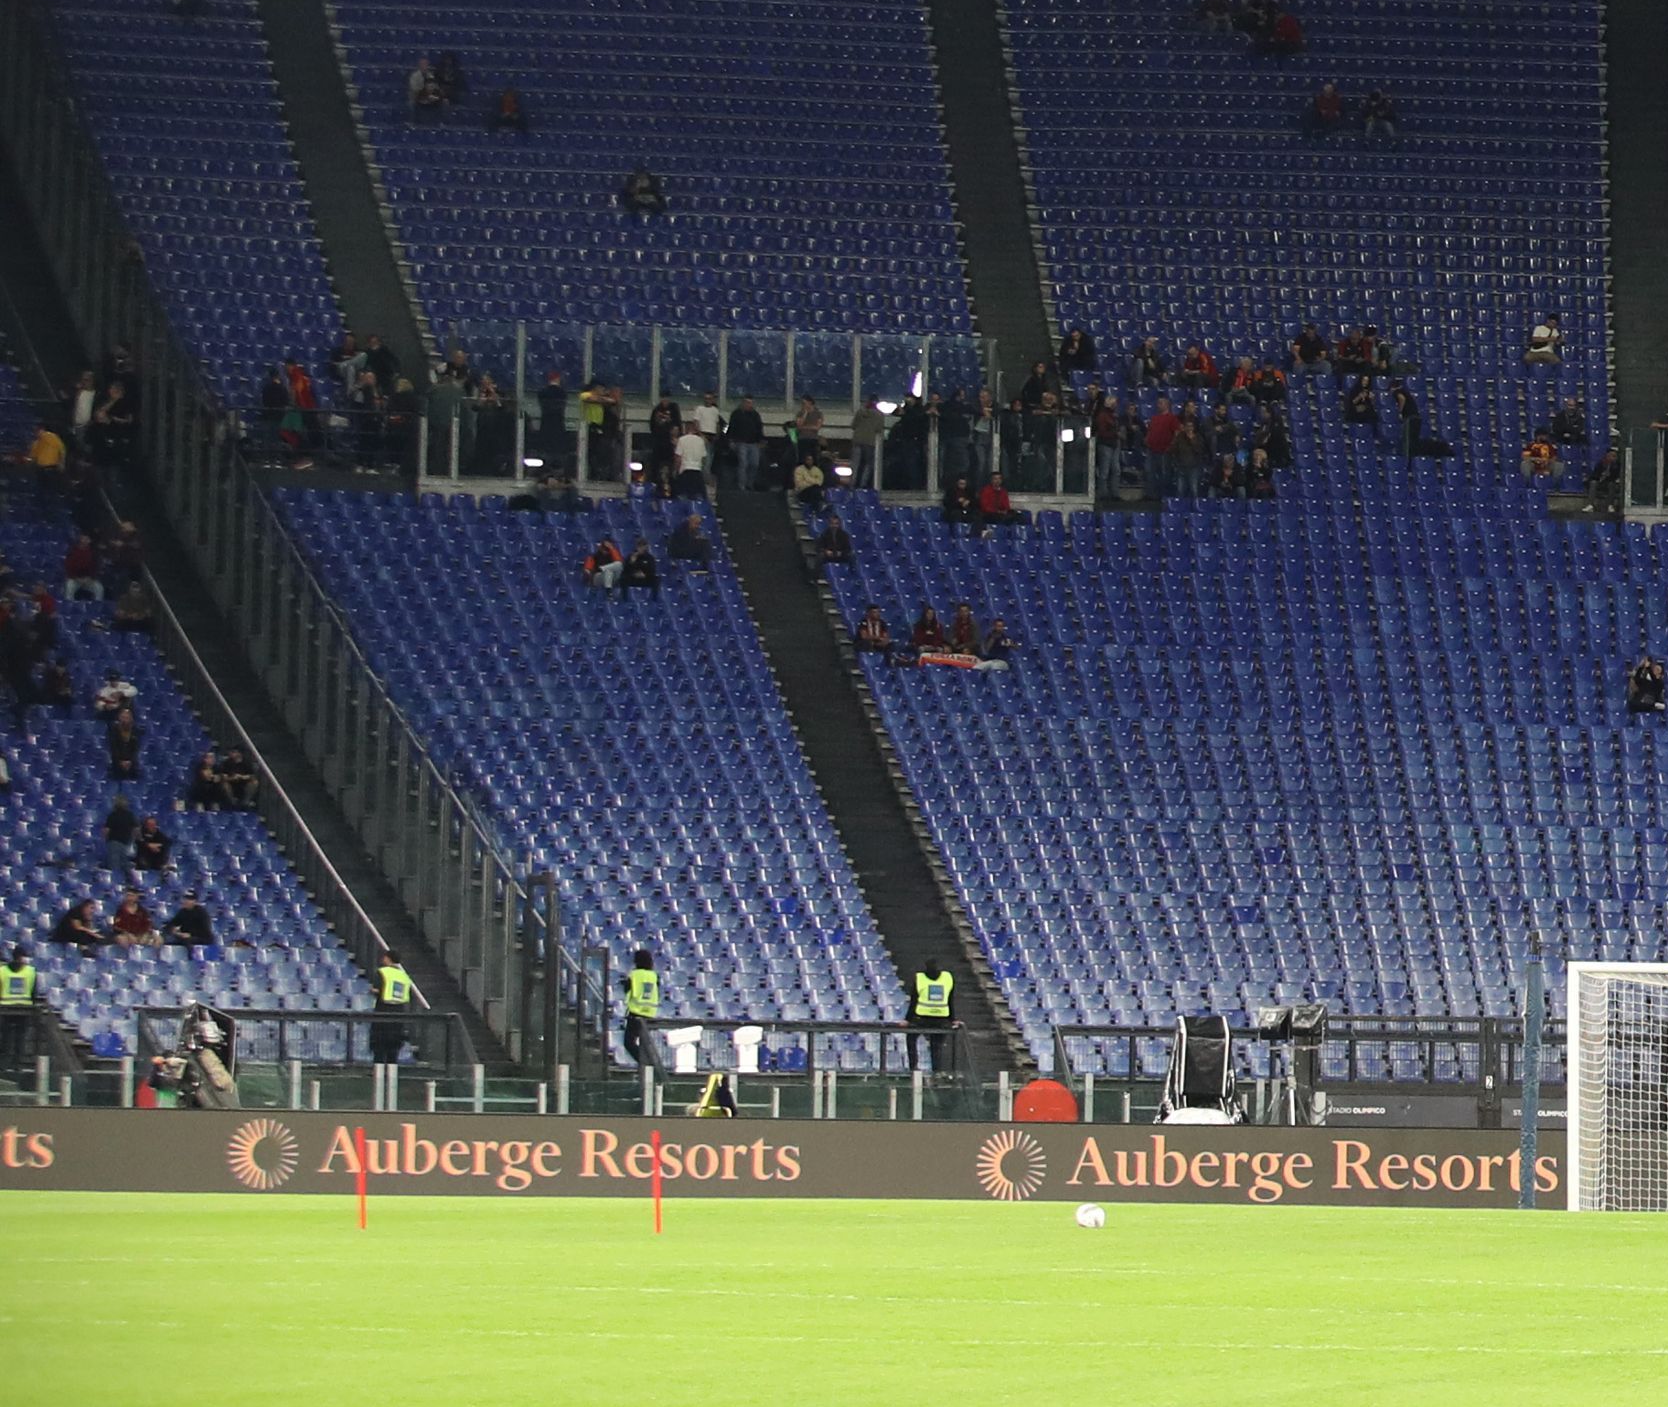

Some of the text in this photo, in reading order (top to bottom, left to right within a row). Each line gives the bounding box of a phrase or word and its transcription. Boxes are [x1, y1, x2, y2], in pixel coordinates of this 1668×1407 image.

[1353, 1107, 1386, 1115] OLIMPICO
[317, 1123, 801, 1191] Auberge Resorts
[1067, 1134, 1313, 1202] Auberge
